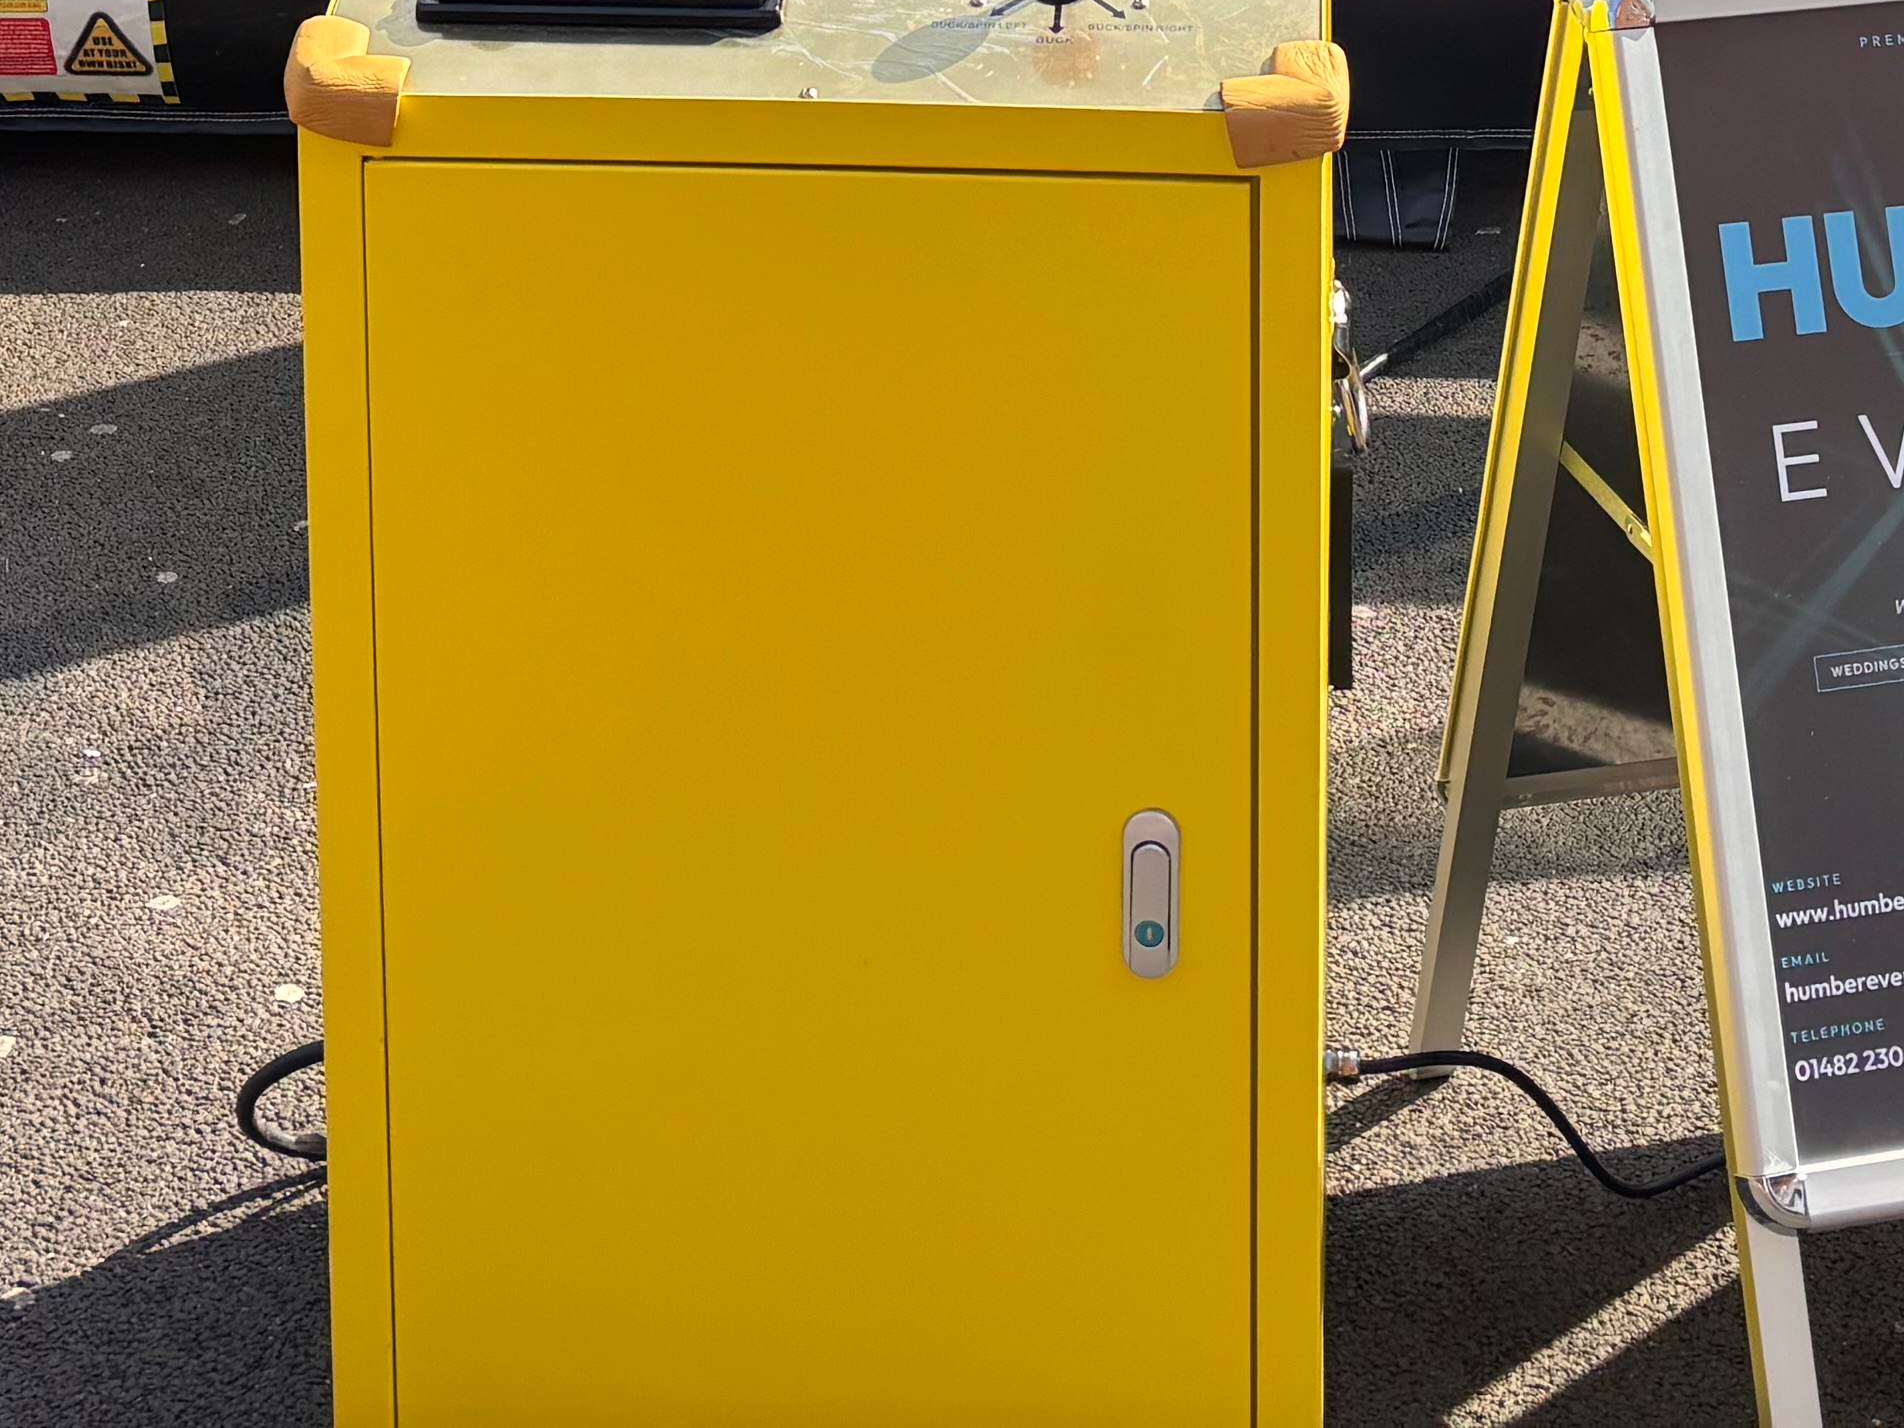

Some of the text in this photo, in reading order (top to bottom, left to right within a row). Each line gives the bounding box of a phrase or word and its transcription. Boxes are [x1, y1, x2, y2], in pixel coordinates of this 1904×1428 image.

[1771, 873, 1841, 894] WEBSITE
[1780, 952, 1830, 969] EMAIL
[1790, 1018, 1885, 1044] TELEPHONE
[1794, 1052, 1861, 1082] 01482
